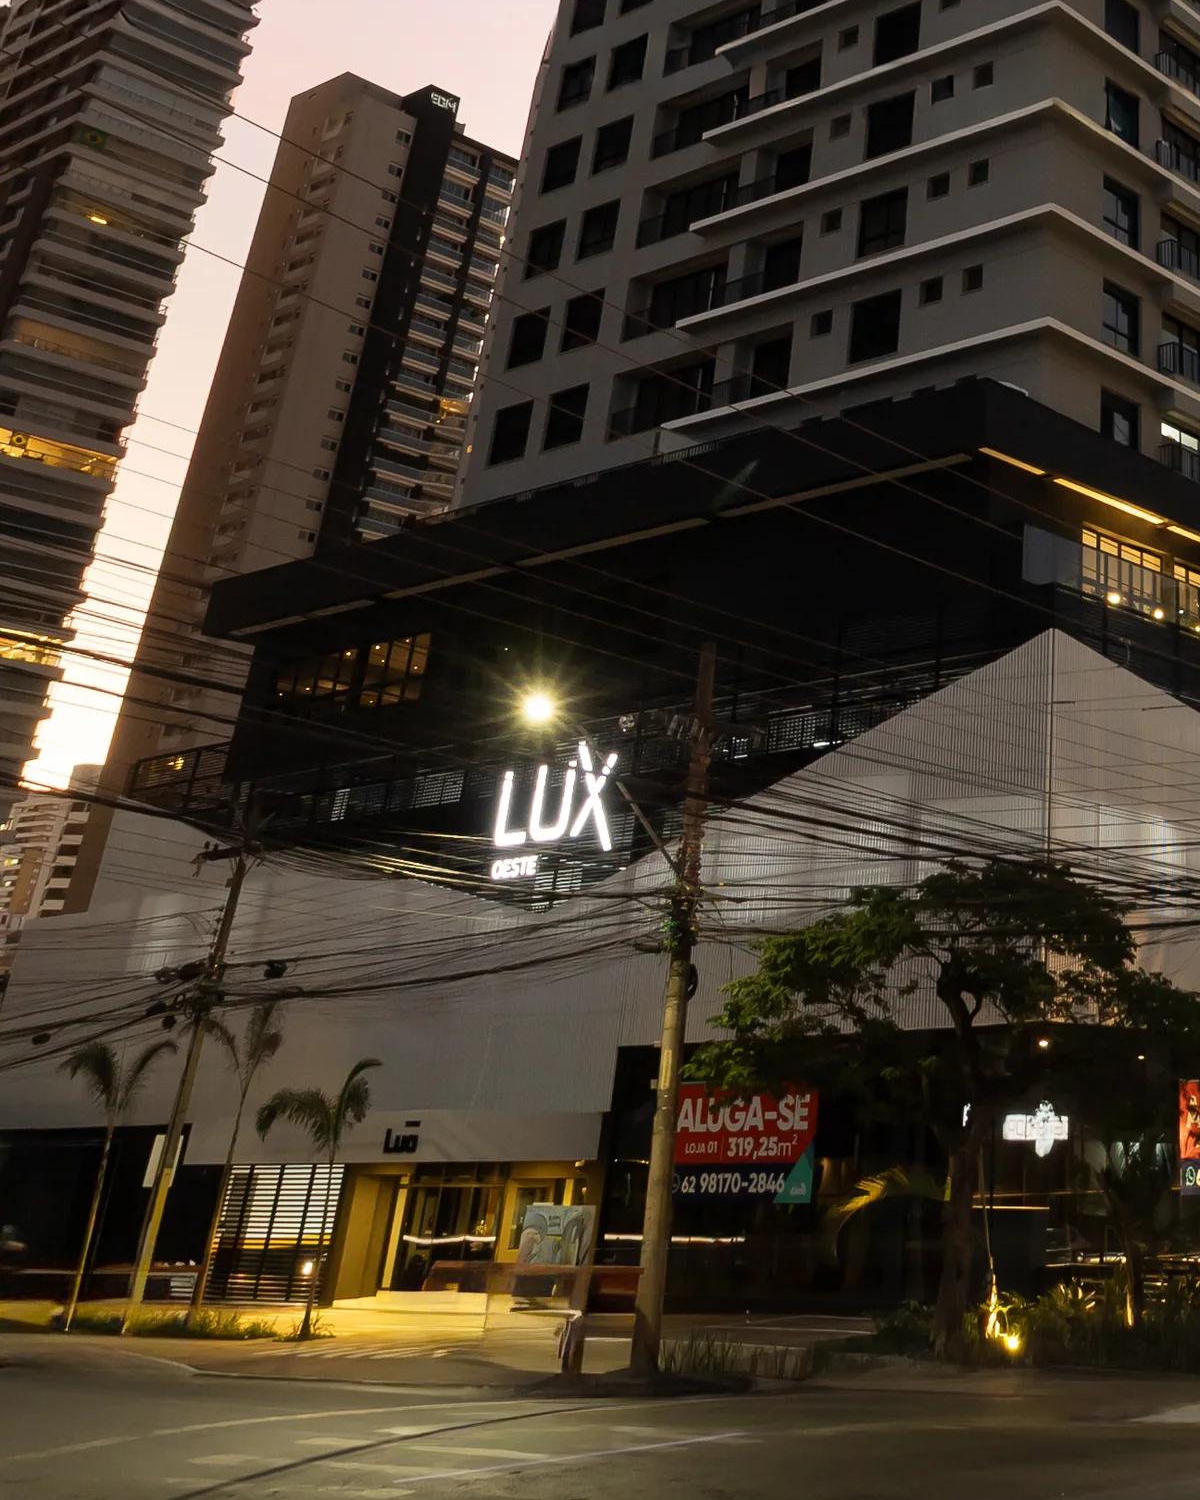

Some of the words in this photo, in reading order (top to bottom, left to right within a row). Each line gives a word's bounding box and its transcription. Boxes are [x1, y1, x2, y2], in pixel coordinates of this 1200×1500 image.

[495, 741, 618, 851] LUX
[491, 855, 538, 880] OESTE
[677, 1094, 811, 1133] ALUGA-SE
[685, 1142, 706, 1154] LOJA
[707, 1141, 717, 1153] 01
[681, 1176, 696, 1193] 62
[700, 1172, 785, 1193] 98170-2846
